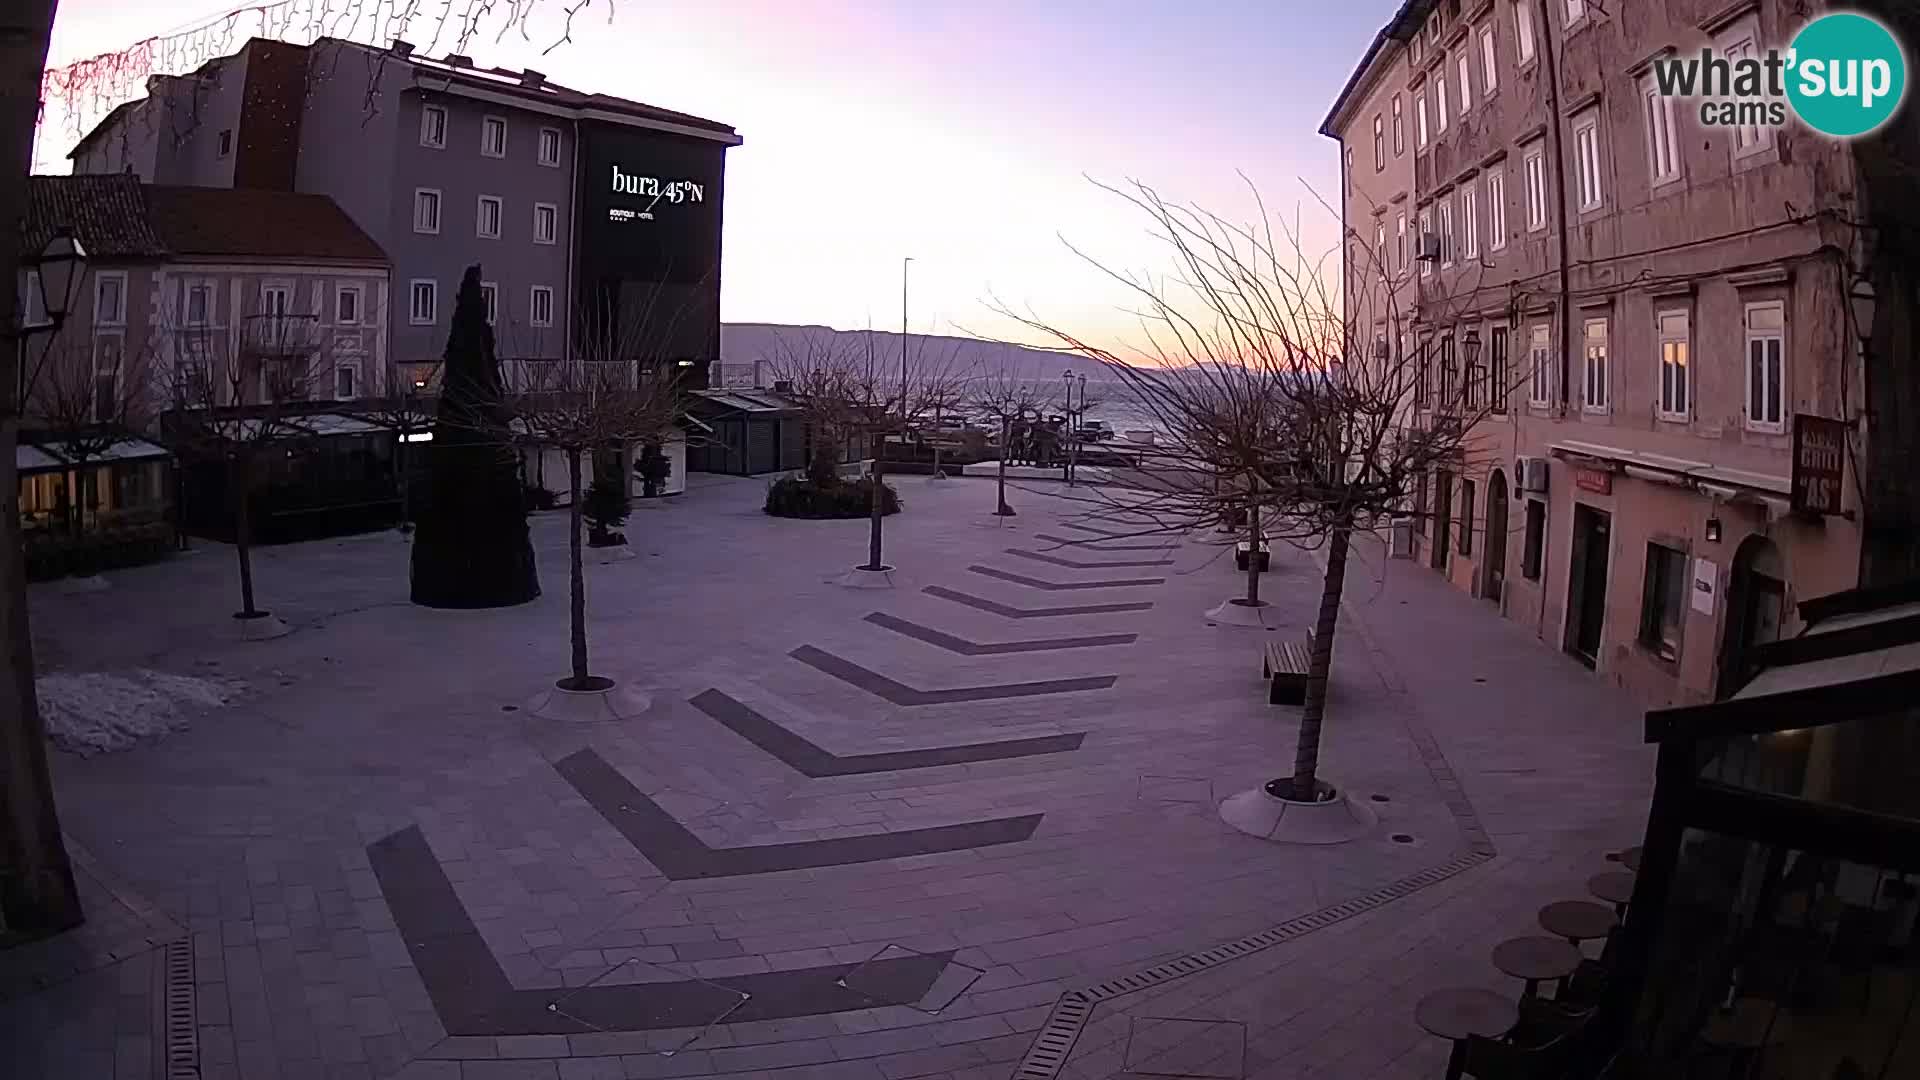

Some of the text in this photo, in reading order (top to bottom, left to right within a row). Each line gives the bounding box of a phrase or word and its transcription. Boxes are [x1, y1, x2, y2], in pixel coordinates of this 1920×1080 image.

[612, 165, 659, 197] bura
[609, 208, 654, 220] BOUTIQUE HOTEL
